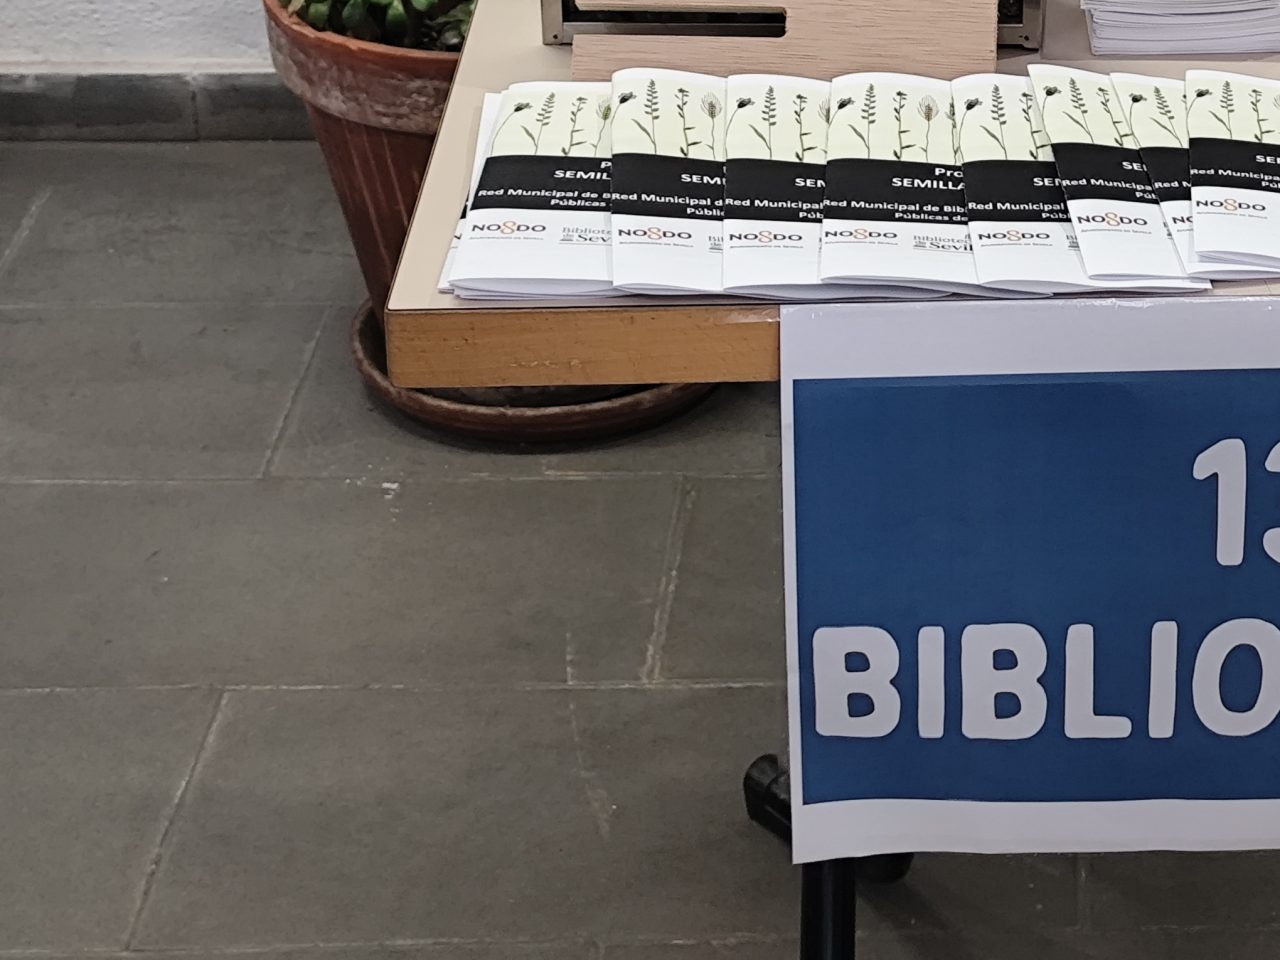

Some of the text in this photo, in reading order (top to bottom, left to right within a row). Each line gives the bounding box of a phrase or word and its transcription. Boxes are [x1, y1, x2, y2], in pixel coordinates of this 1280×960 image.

[1063, 178, 1087, 187] Red
[1155, 181, 1181, 189] Red
[507, 188, 579, 198] Municipal
[550, 198, 606, 207] Públicas
[612, 193, 710, 206] Red Municipal
[725, 198, 823, 210] Red Municipal
[851, 201, 920, 211] Municipal
[923, 204, 939, 212] de
[968, 202, 1064, 211] Red Municipal
[895, 212, 949, 220] Públicas
